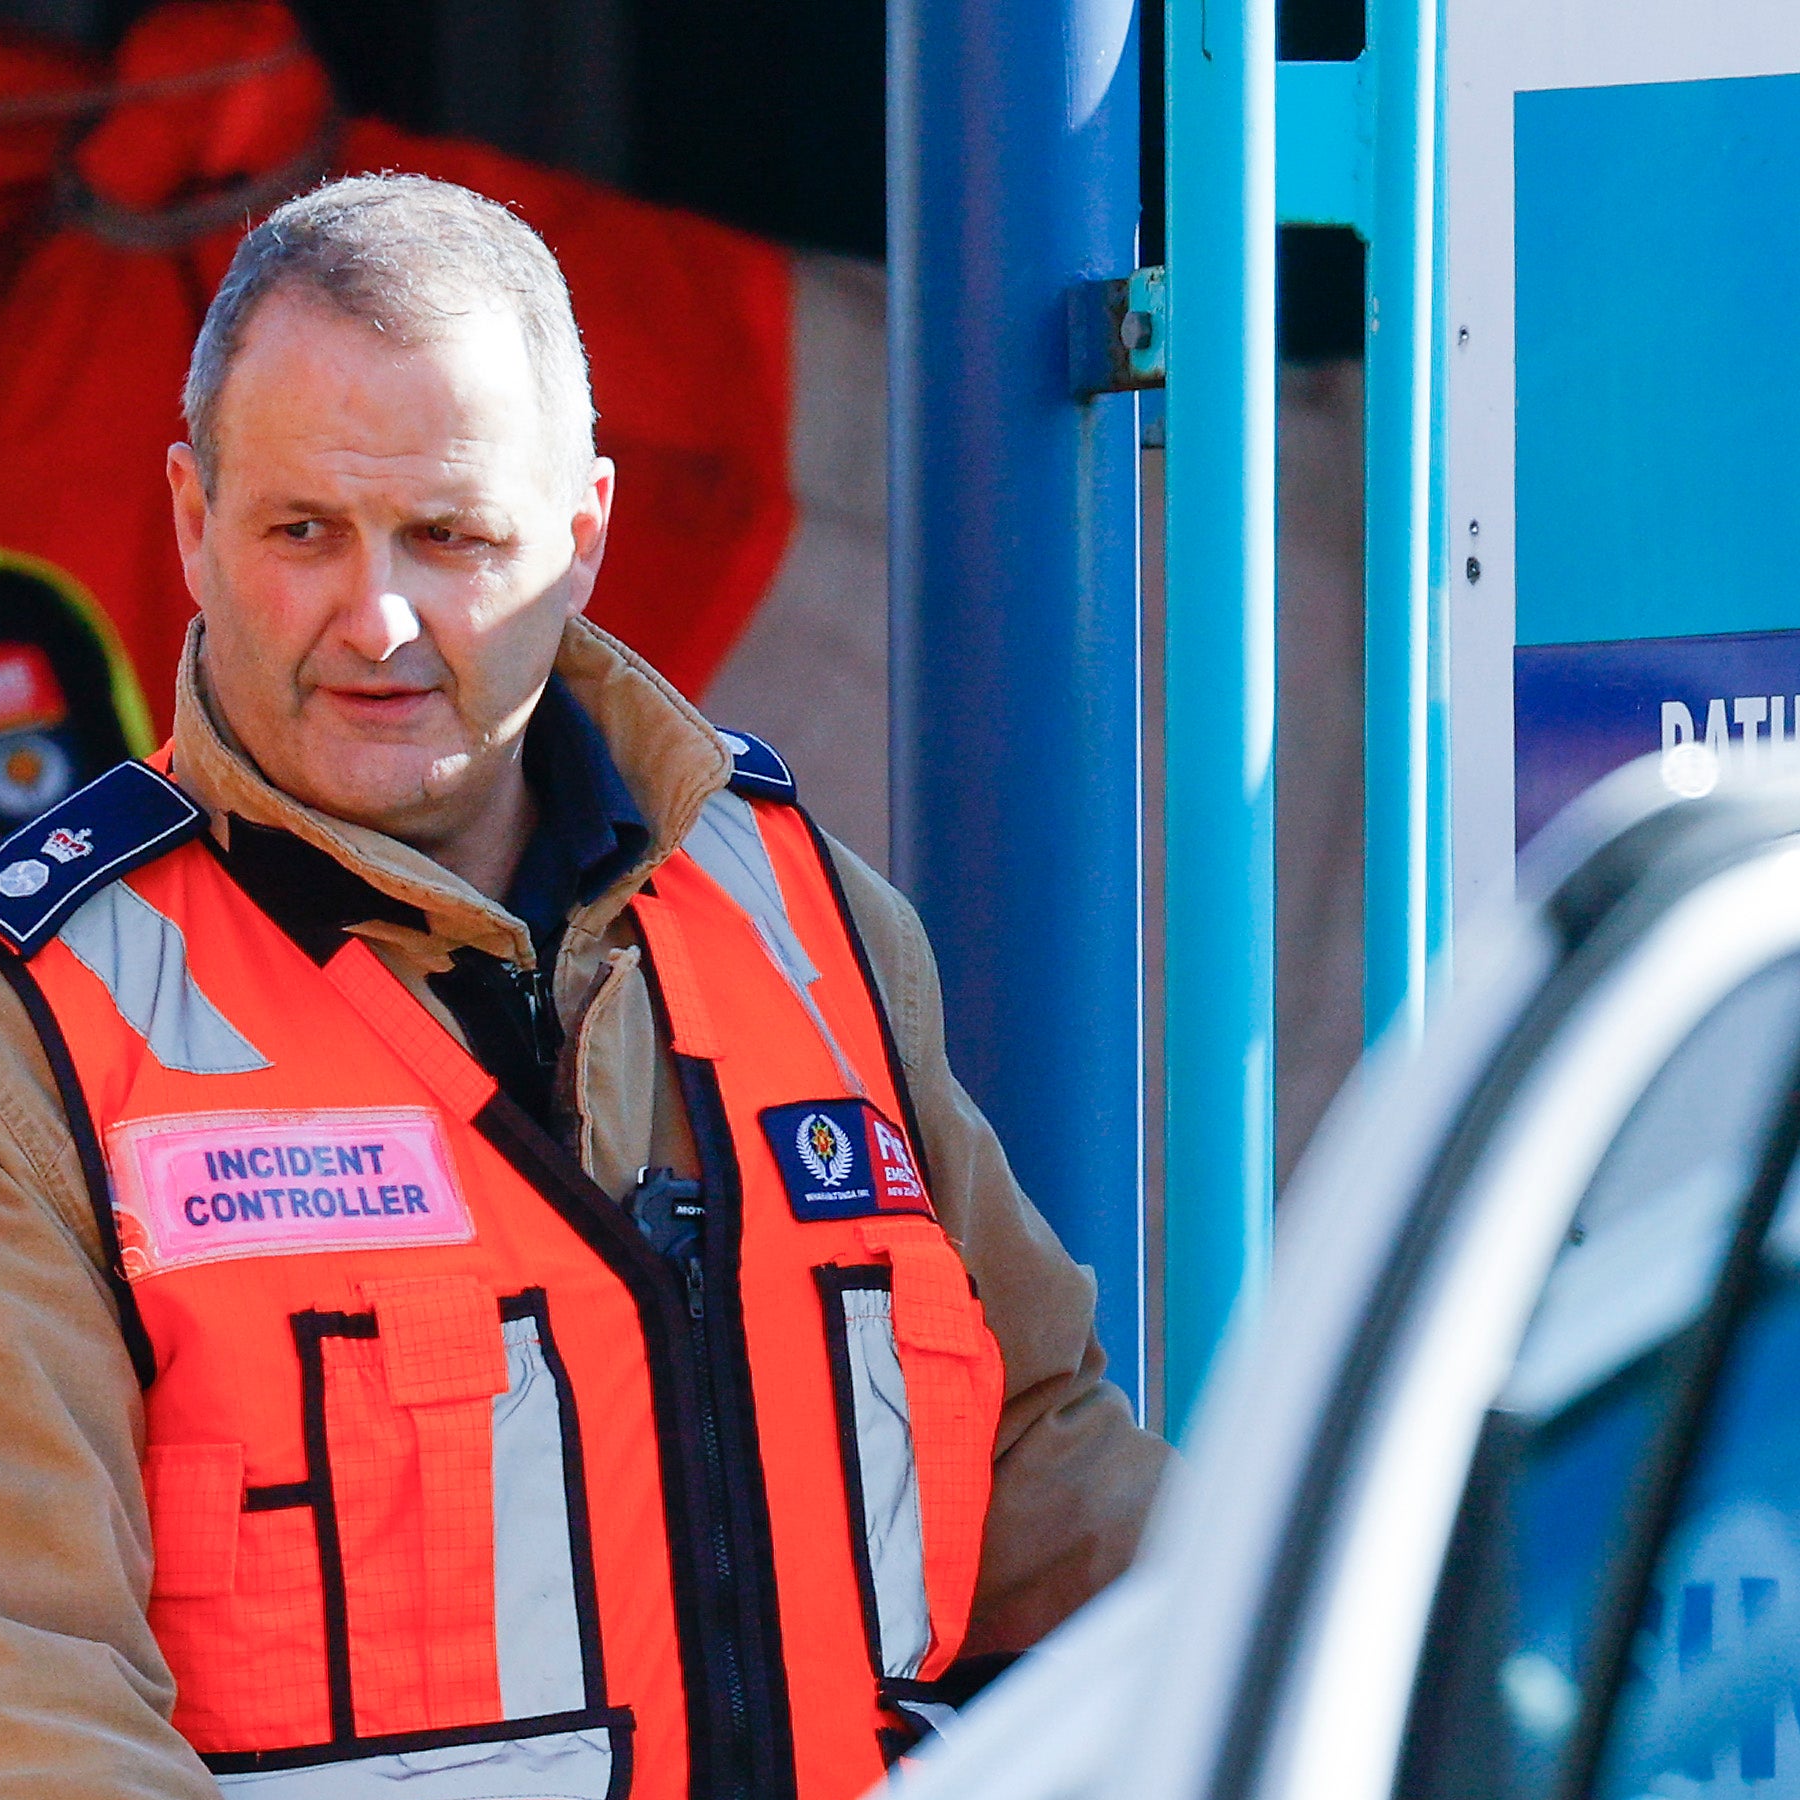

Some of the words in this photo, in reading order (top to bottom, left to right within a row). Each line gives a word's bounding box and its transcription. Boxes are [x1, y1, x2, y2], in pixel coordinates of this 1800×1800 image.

[204, 1145, 385, 1180] INCIDENT
[184, 1184, 430, 1226] CONTROLLER
[675, 1205, 705, 1215] MOT
